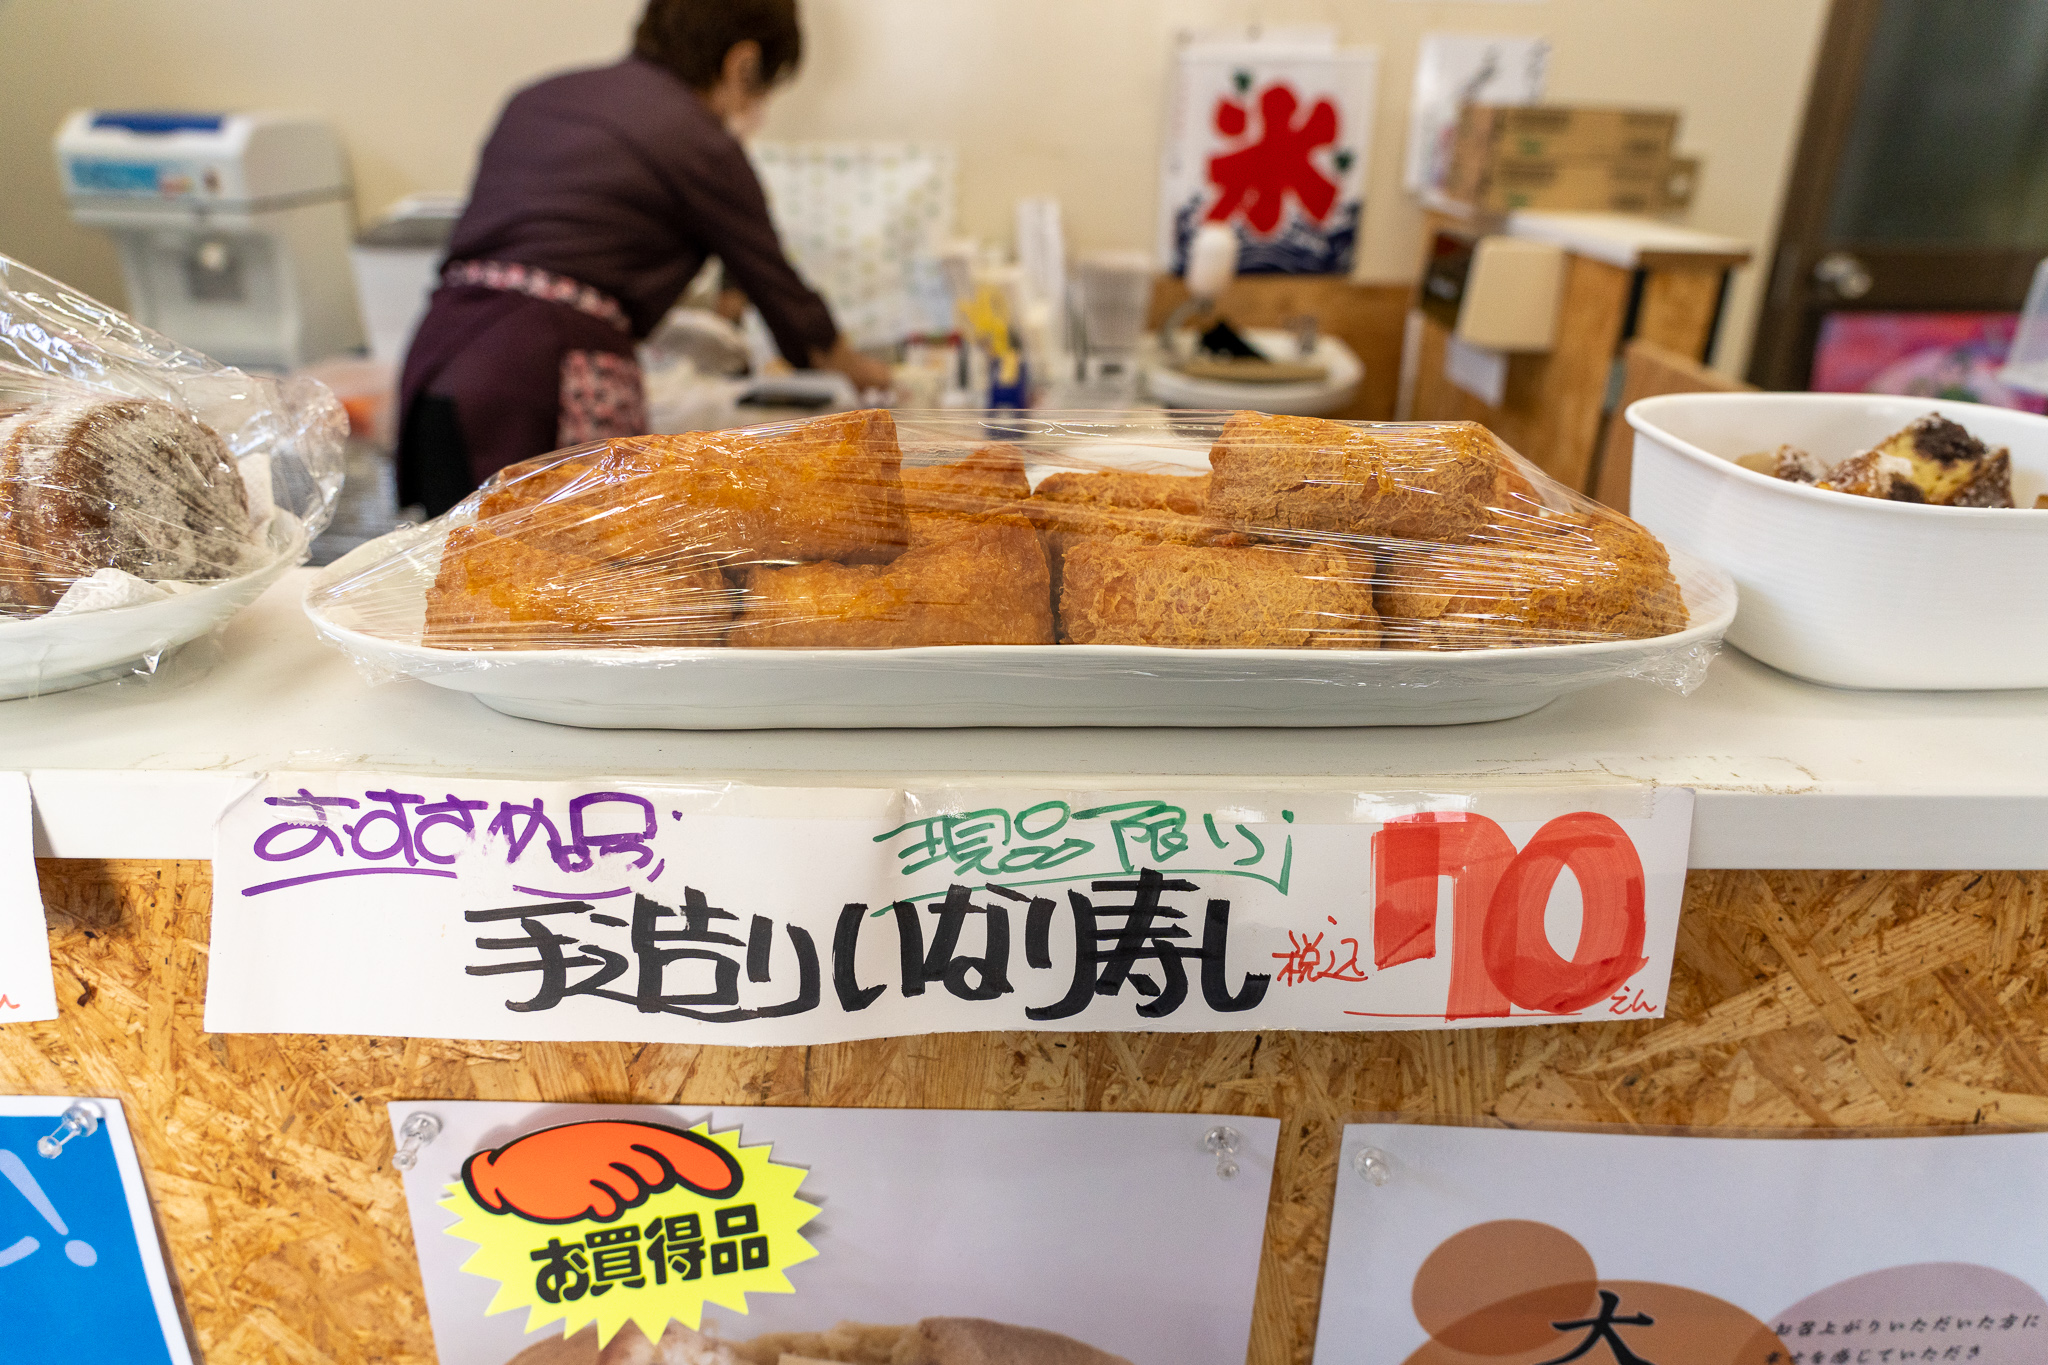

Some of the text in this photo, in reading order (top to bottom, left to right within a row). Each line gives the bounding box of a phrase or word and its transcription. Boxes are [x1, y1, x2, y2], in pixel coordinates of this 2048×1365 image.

[1271, 914, 1369, 987] 税込
[1608, 985, 1658, 1015] えん
[530, 1203, 770, 1304] お買得品
[1533, 1288, 1660, 1365] 大
